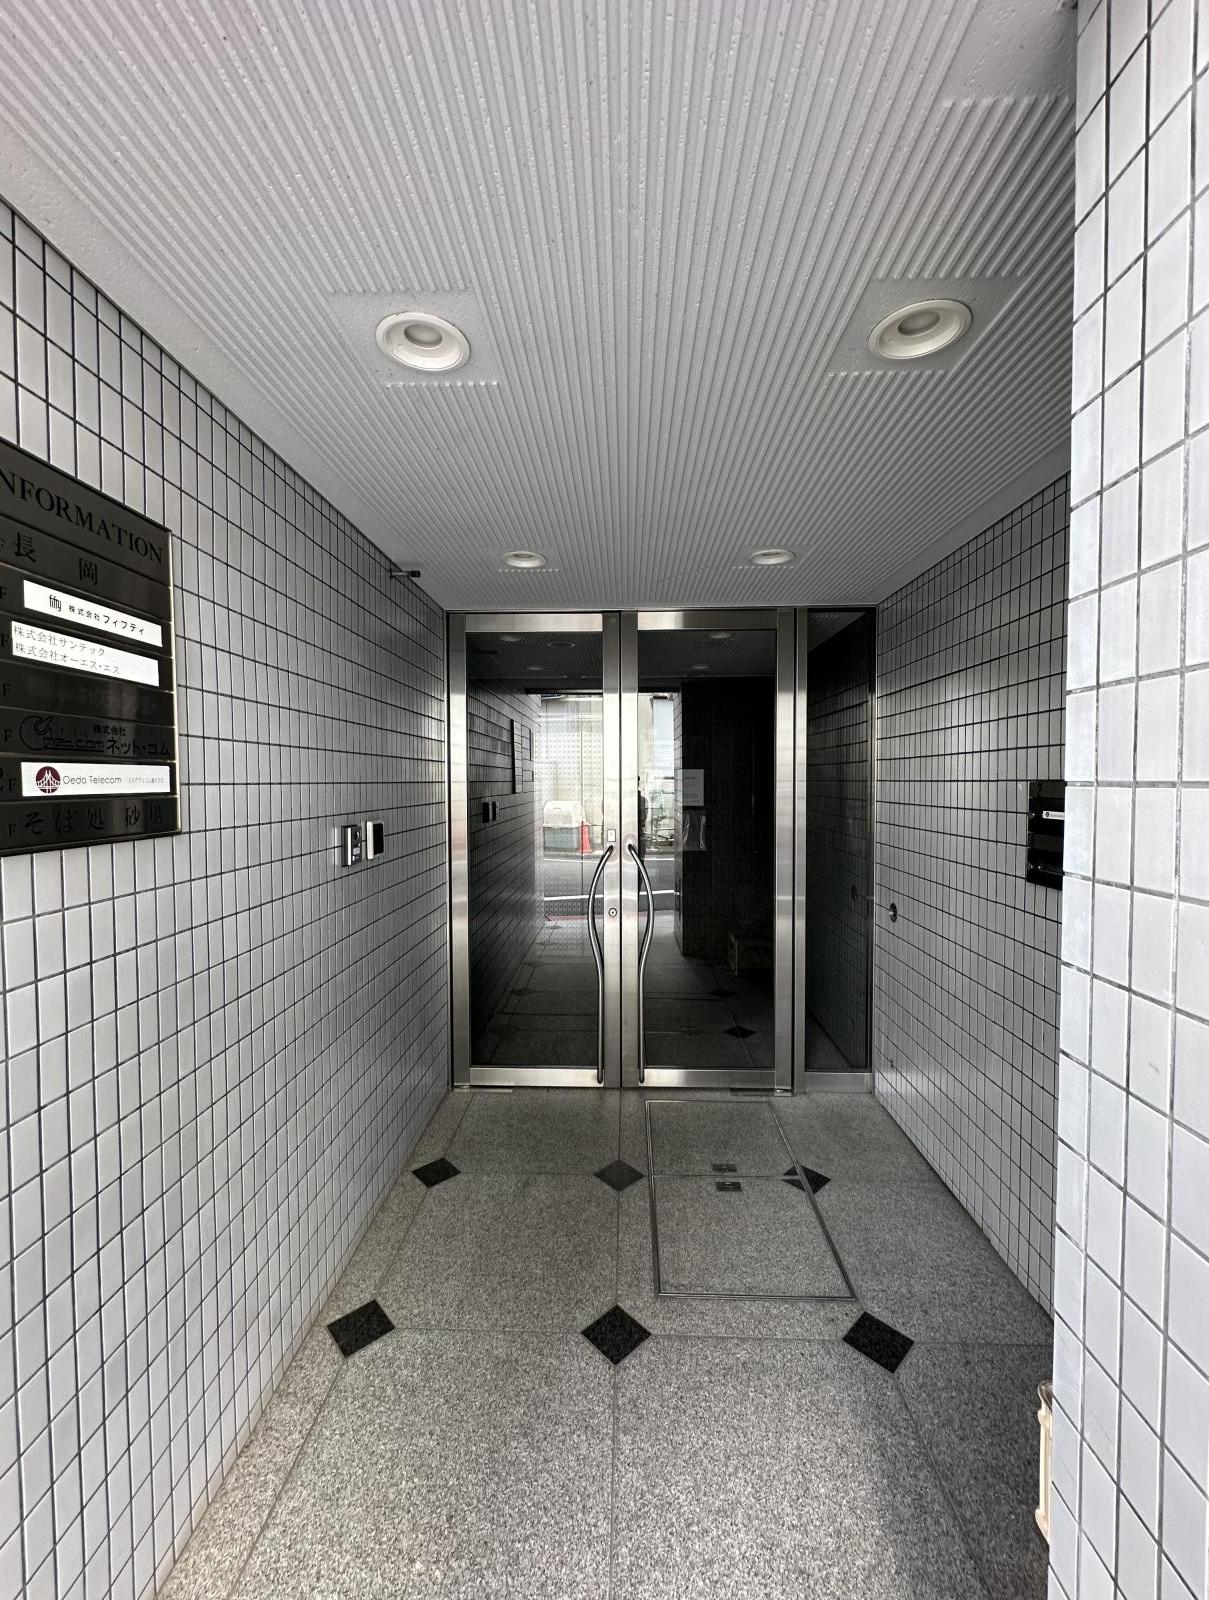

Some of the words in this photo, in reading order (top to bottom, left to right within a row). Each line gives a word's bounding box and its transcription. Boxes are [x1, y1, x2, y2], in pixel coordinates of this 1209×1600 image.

[14, 625, 105, 657] 株式会社サンテック
[62, 775, 87, 785] Oedo
[88, 775, 122, 785] Telecom
